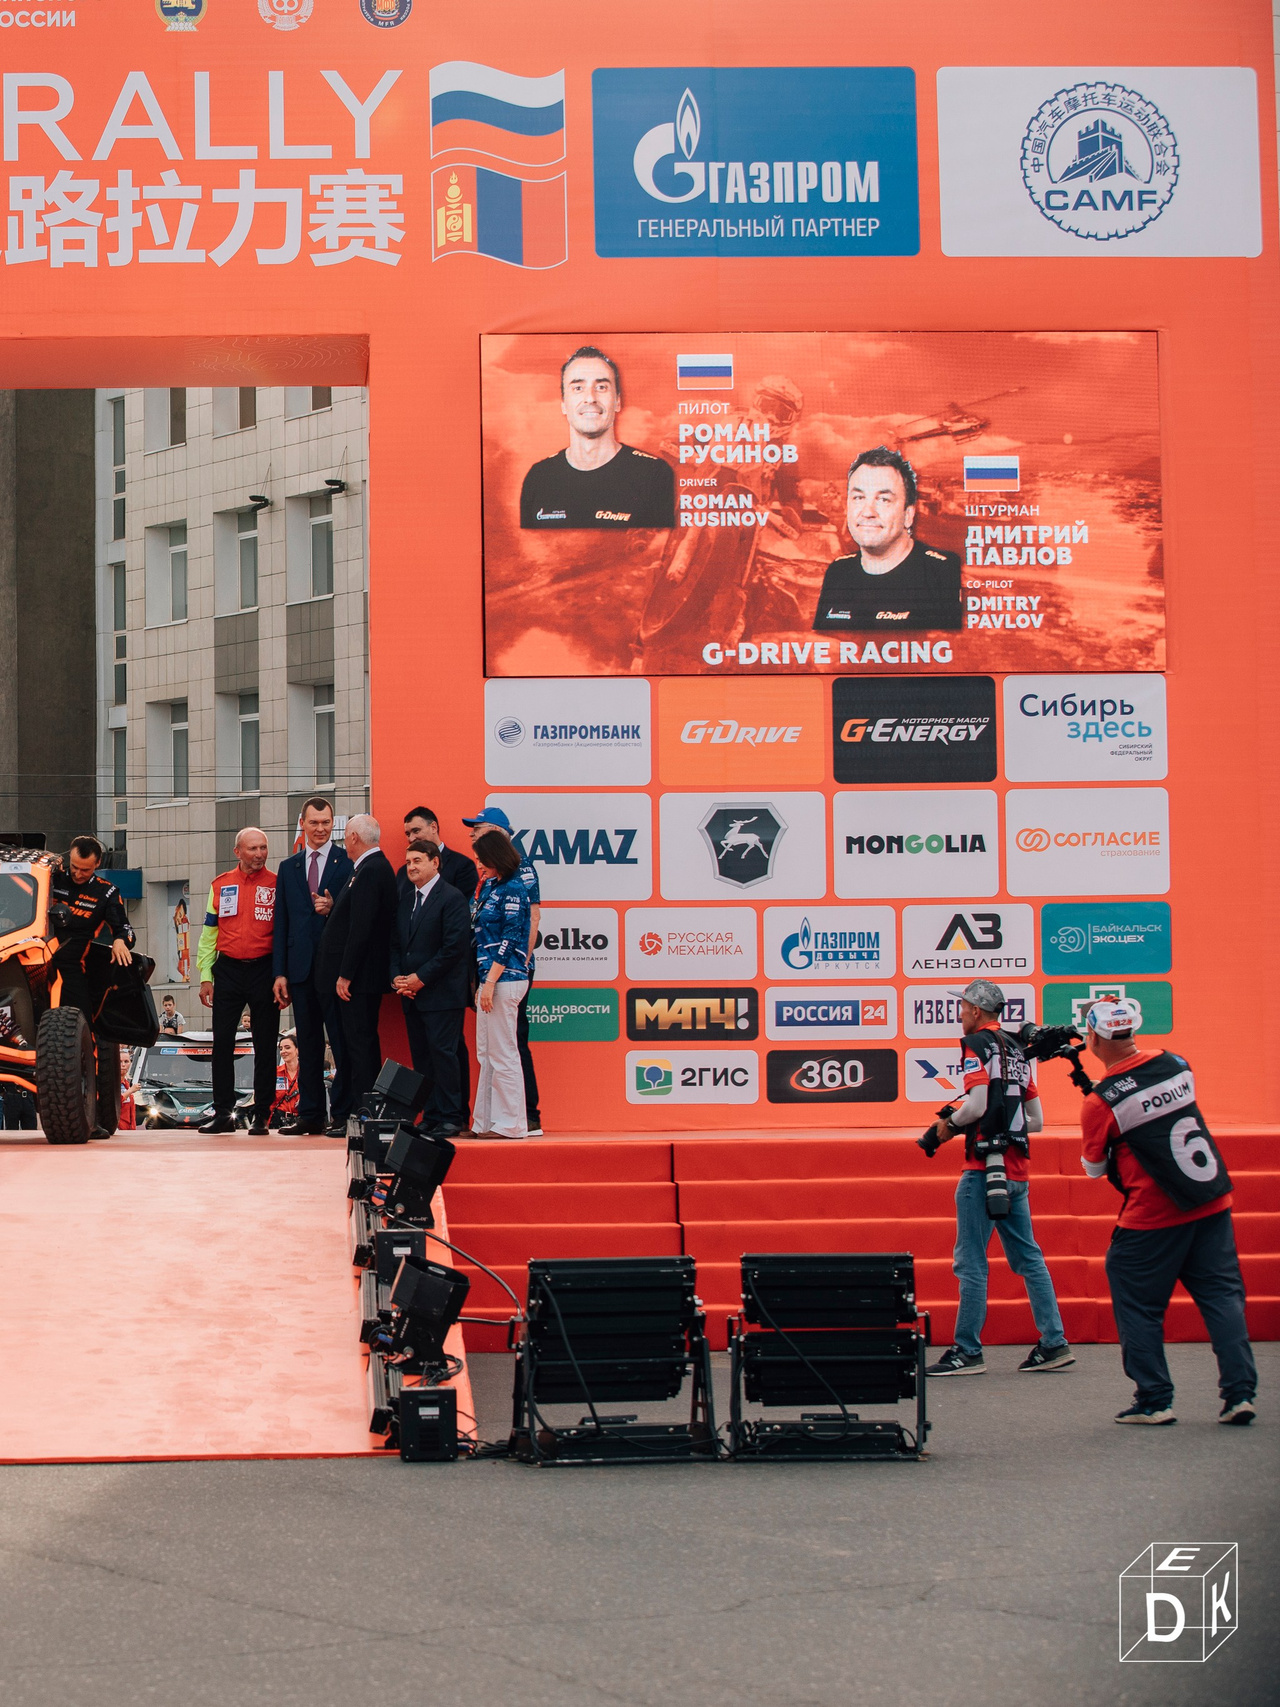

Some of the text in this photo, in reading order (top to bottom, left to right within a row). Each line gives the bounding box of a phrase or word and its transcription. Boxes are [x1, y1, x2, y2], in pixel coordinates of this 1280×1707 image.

[3, 70, 403, 161] RALLY
[708, 161, 880, 203] ГАЗПРОМ
[1044, 189, 1157, 211] CAMF
[637, 214, 880, 238] ГЕНЕРАЛЬНЫЙ ПАРТНЕР
[678, 402, 730, 415] ПИЛОТ
[679, 423, 770, 442] РОМАН
[679, 444, 799, 464] РУСИНОВ
[679, 478, 717, 487] DRIVER
[680, 494, 753, 510] ROMAN
[680, 510, 770, 527] RUSINOV
[965, 504, 1040, 517] ШТУРМАН
[965, 520, 1089, 548] ДМИТРИЙ
[965, 547, 1073, 566] ПАВЛОВ
[966, 580, 1014, 589] CO-PILOT
[967, 595, 1041, 611] DMITRY
[967, 613, 1044, 630] PAVLOV
[702, 640, 953, 665] G-DRIVE RACING
[1019, 693, 1134, 721] Сибирь
[533, 725, 641, 740] ГАЗПРОМБАНК
[1067, 719, 1152, 742] здесь
[845, 834, 986, 854] MONGOLIA
[1054, 831, 1160, 847] СОГЛАСИЕ
[1100, 849, 1160, 858] страхование
[254, 913, 273, 921] WAY
[1092, 923, 1162, 933] БАЙКАЛЬСК
[667, 932, 733, 943] РУССКАЯ
[814, 931, 880, 949] ГАЗПРОМ
[1092, 934, 1145, 945] ЭКО.ЦЕХ
[667, 945, 744, 956] МЕХАНИКА
[816, 951, 878, 960] ДОБЫЧА
[814, 962, 880, 970] ИРКУТСК
[912, 957, 1027, 969] ЛЕНЗОЛОТО
[552, 1005, 610, 1014] НОВОСТИ
[635, 998, 749, 1030] МАТЧ!
[782, 1005, 885, 1021] РОССИЯ 24
[681, 1067, 749, 1087] 2ГИС
[801, 1060, 864, 1088] 360
[1114, 1076, 1134, 1088] SILK
[1119, 1081, 1138, 1092] WAY
[1141, 1082, 1191, 1112] PODIUM
[1169, 1116, 1218, 1182] 6
